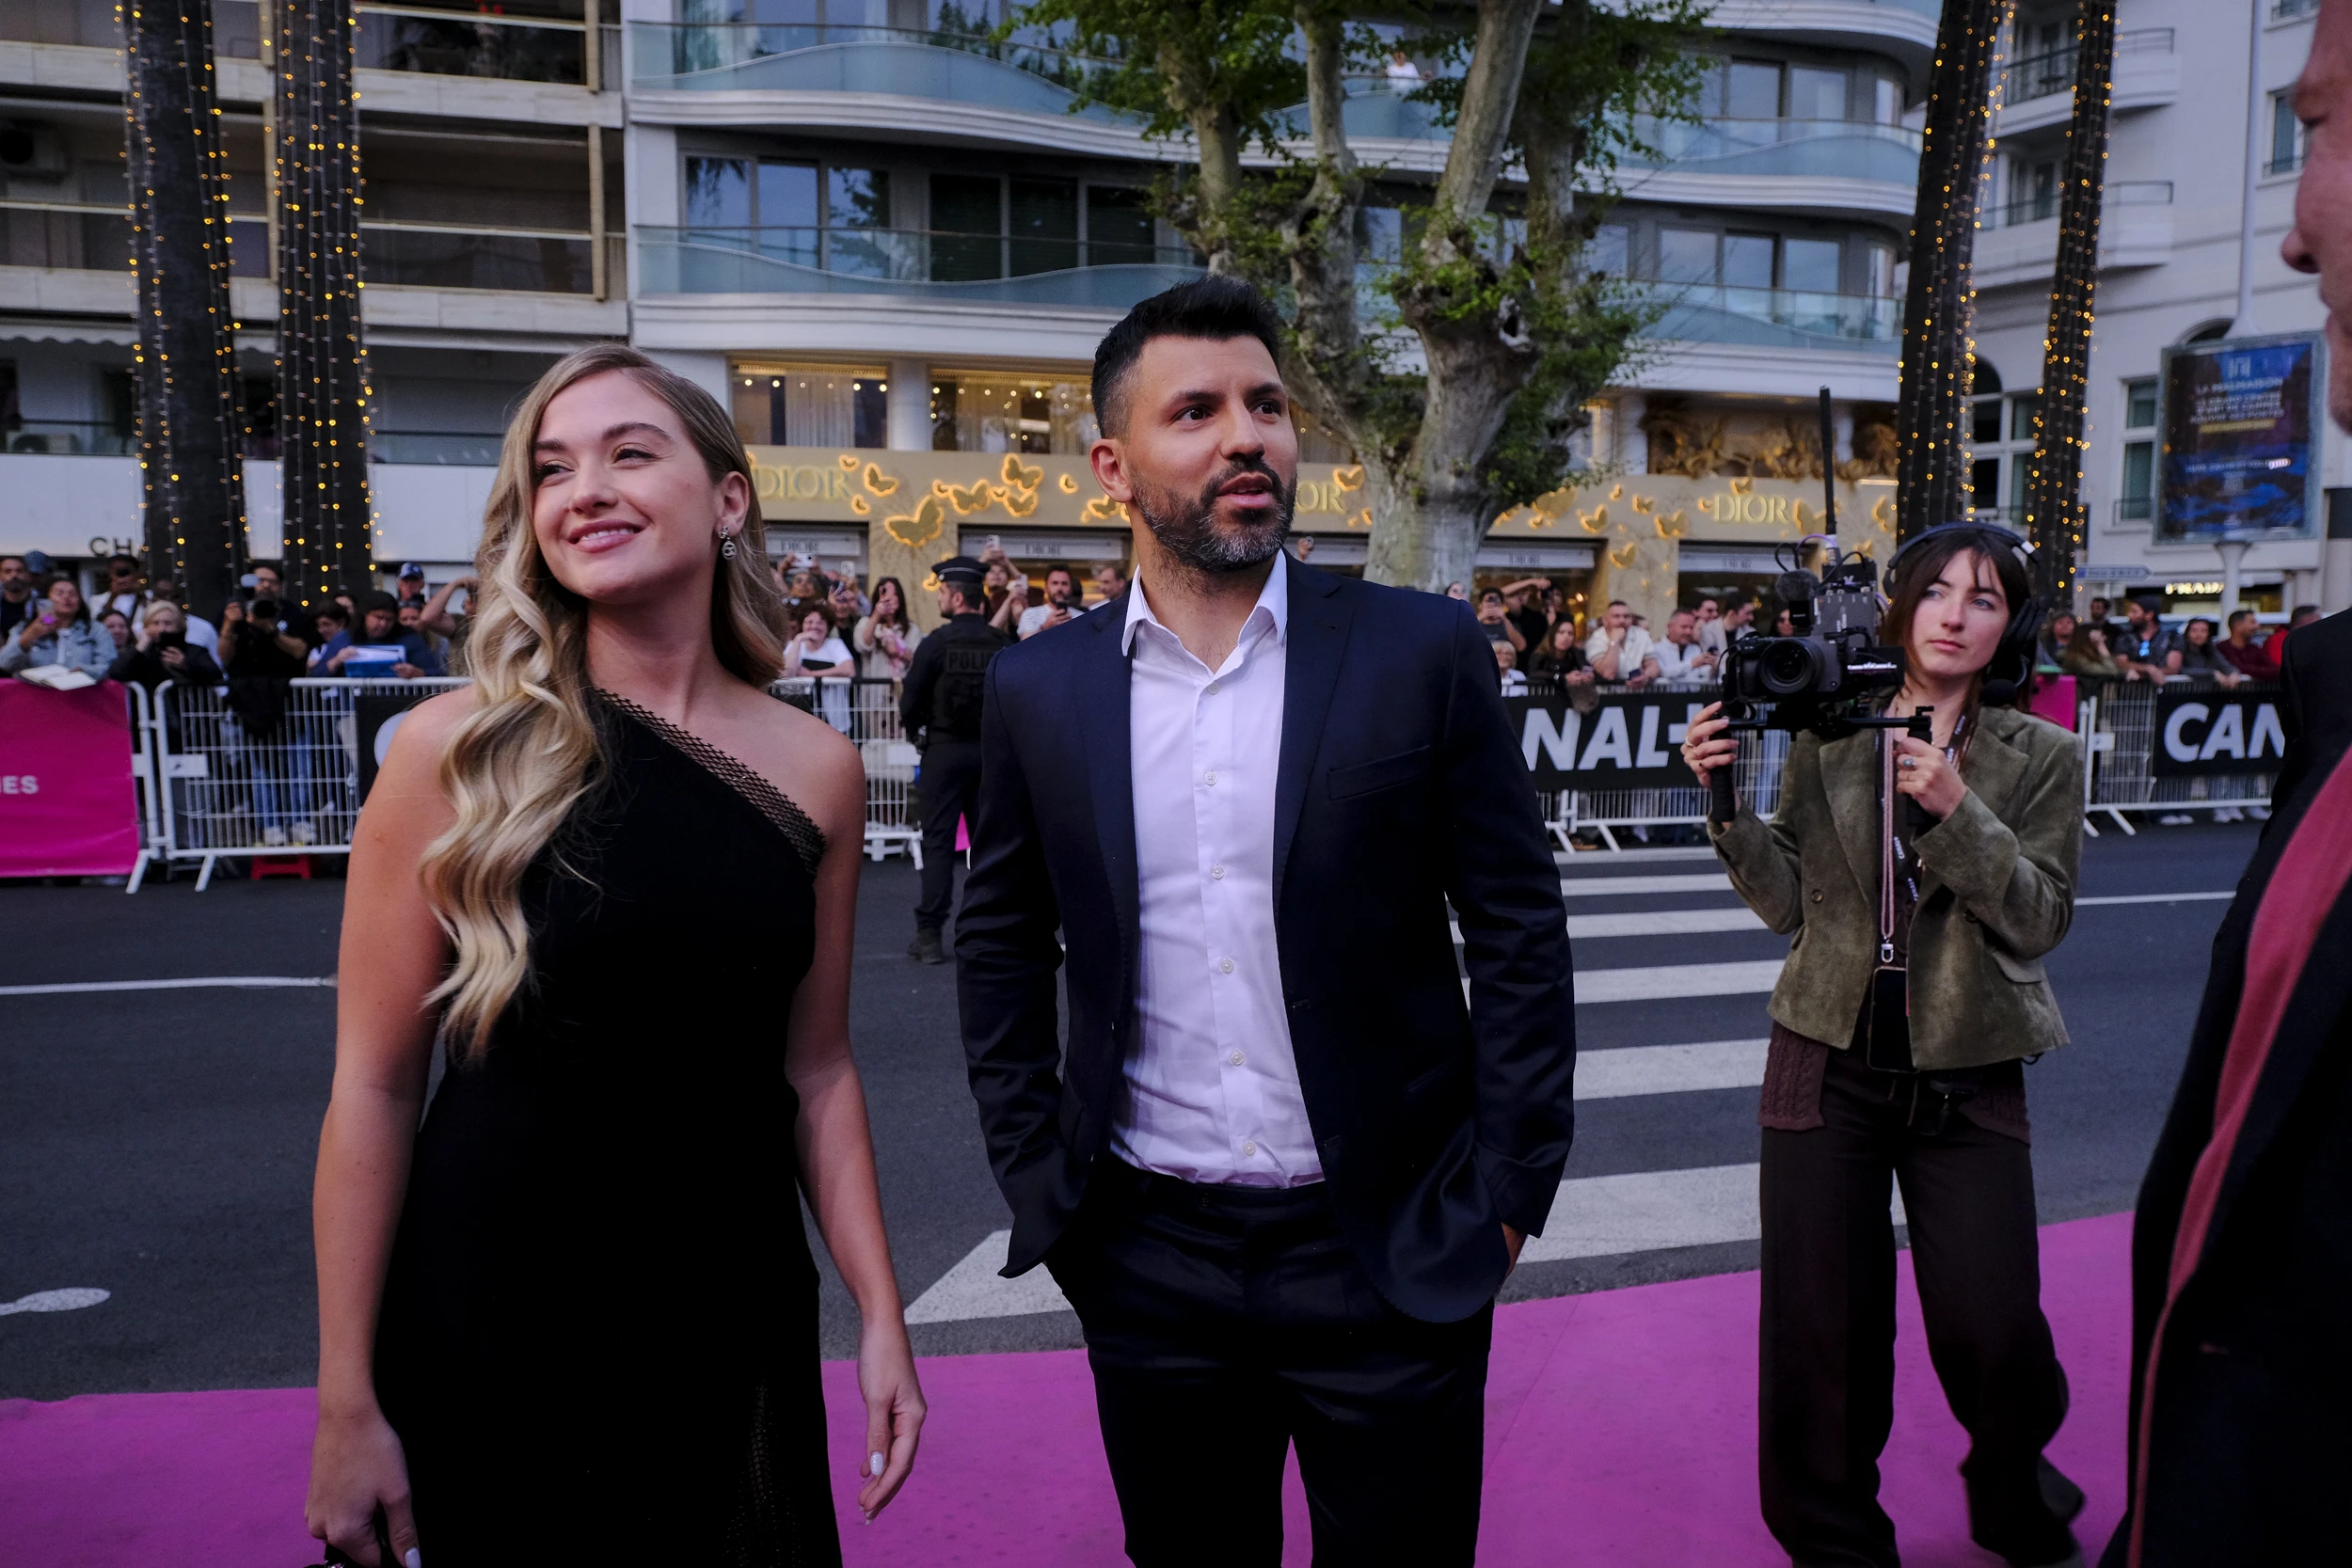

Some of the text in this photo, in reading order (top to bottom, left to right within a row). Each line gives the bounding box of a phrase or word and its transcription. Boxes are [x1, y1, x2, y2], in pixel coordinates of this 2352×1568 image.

[753, 466, 851, 499] DIOR
[1713, 494, 1788, 524] DIOR
[88, 536, 144, 557] CH
[2164, 702, 2286, 763] CAN
[0, 775, 39, 795] ES
